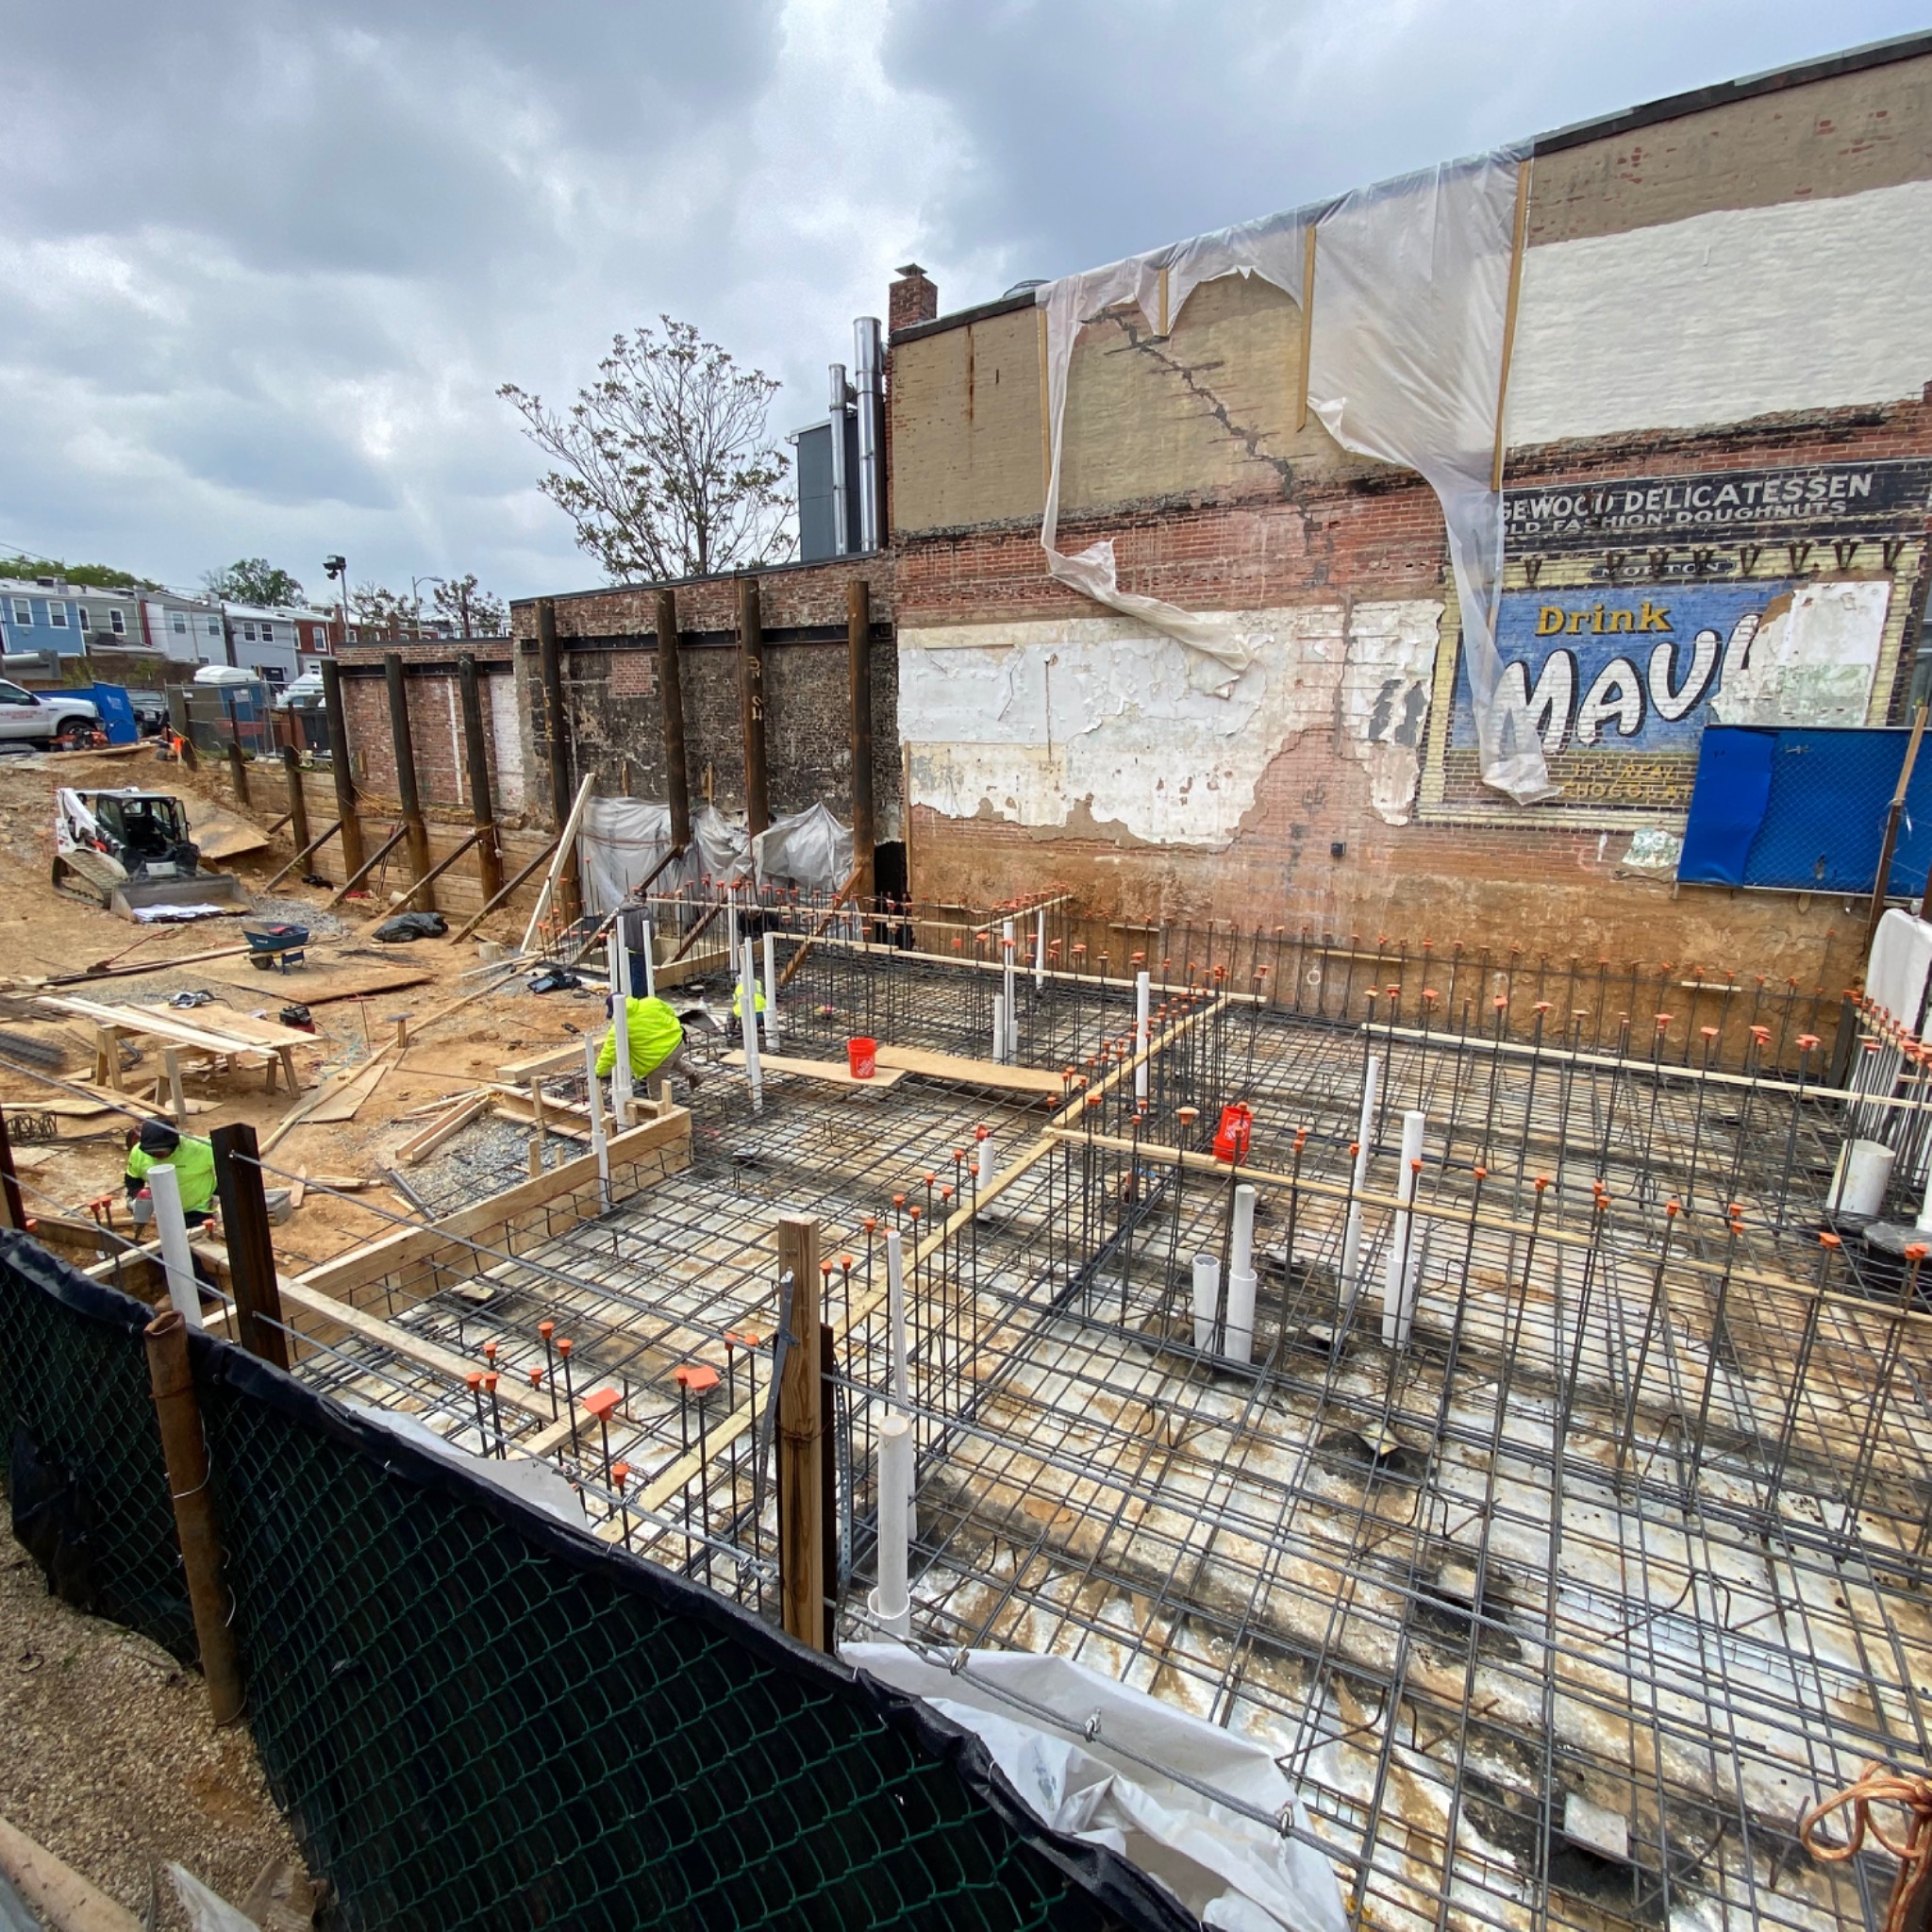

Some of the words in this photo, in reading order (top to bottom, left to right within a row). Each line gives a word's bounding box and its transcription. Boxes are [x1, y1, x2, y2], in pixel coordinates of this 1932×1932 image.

[1624, 474, 1873, 513] DELICATESSEN
[1493, 522, 1541, 536] OLD
[1675, 501, 1847, 523] DOUGHNUTS
[1535, 602, 1675, 637] Drink
